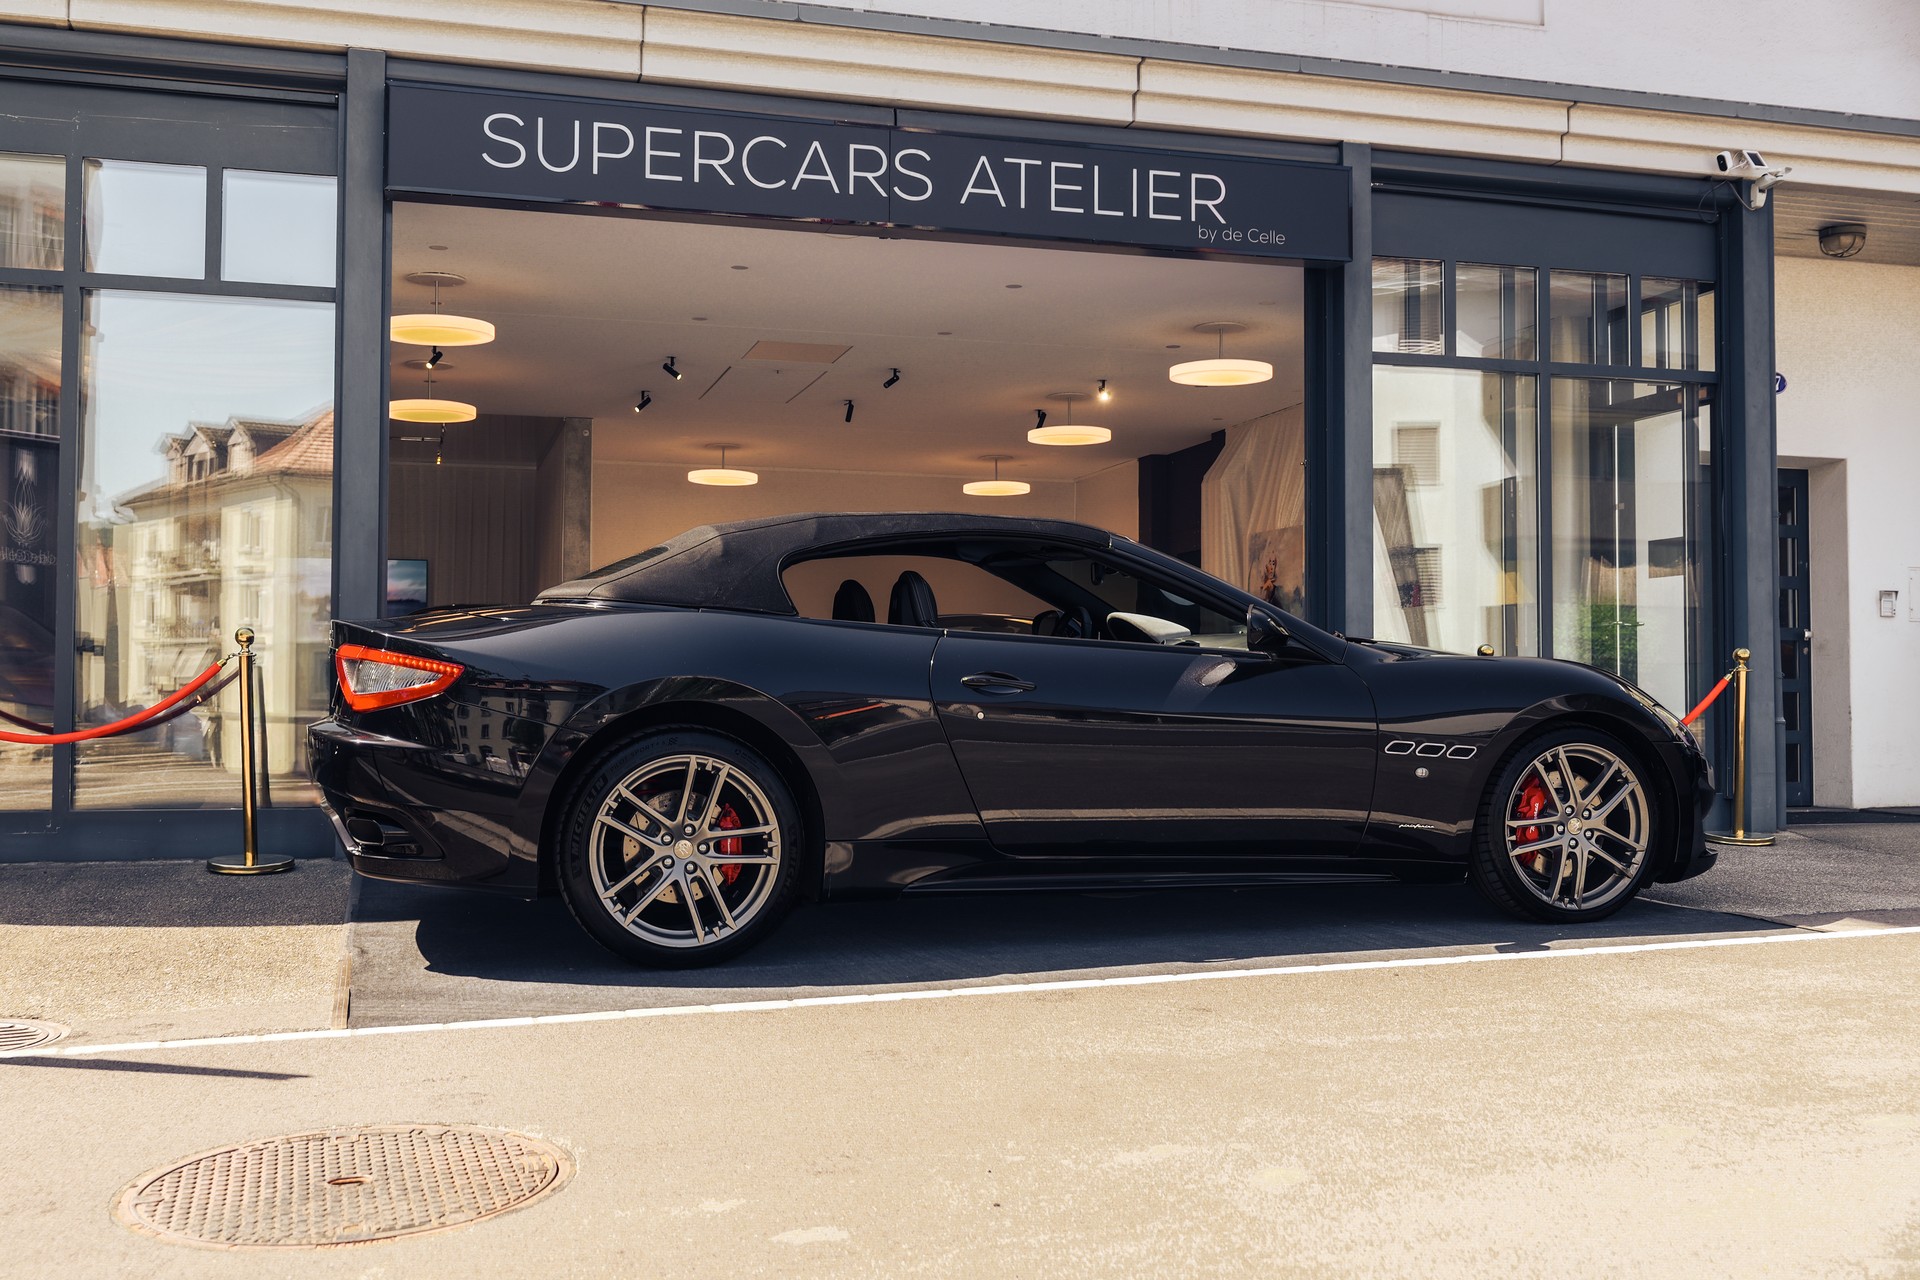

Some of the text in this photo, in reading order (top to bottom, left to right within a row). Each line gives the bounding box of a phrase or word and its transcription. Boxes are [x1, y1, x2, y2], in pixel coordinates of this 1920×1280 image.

[481, 112, 1227, 224] SUPERCARS ATELIER
[1197, 224, 1287, 245] by de Celle
[571, 777, 605, 855] MICHELIN
